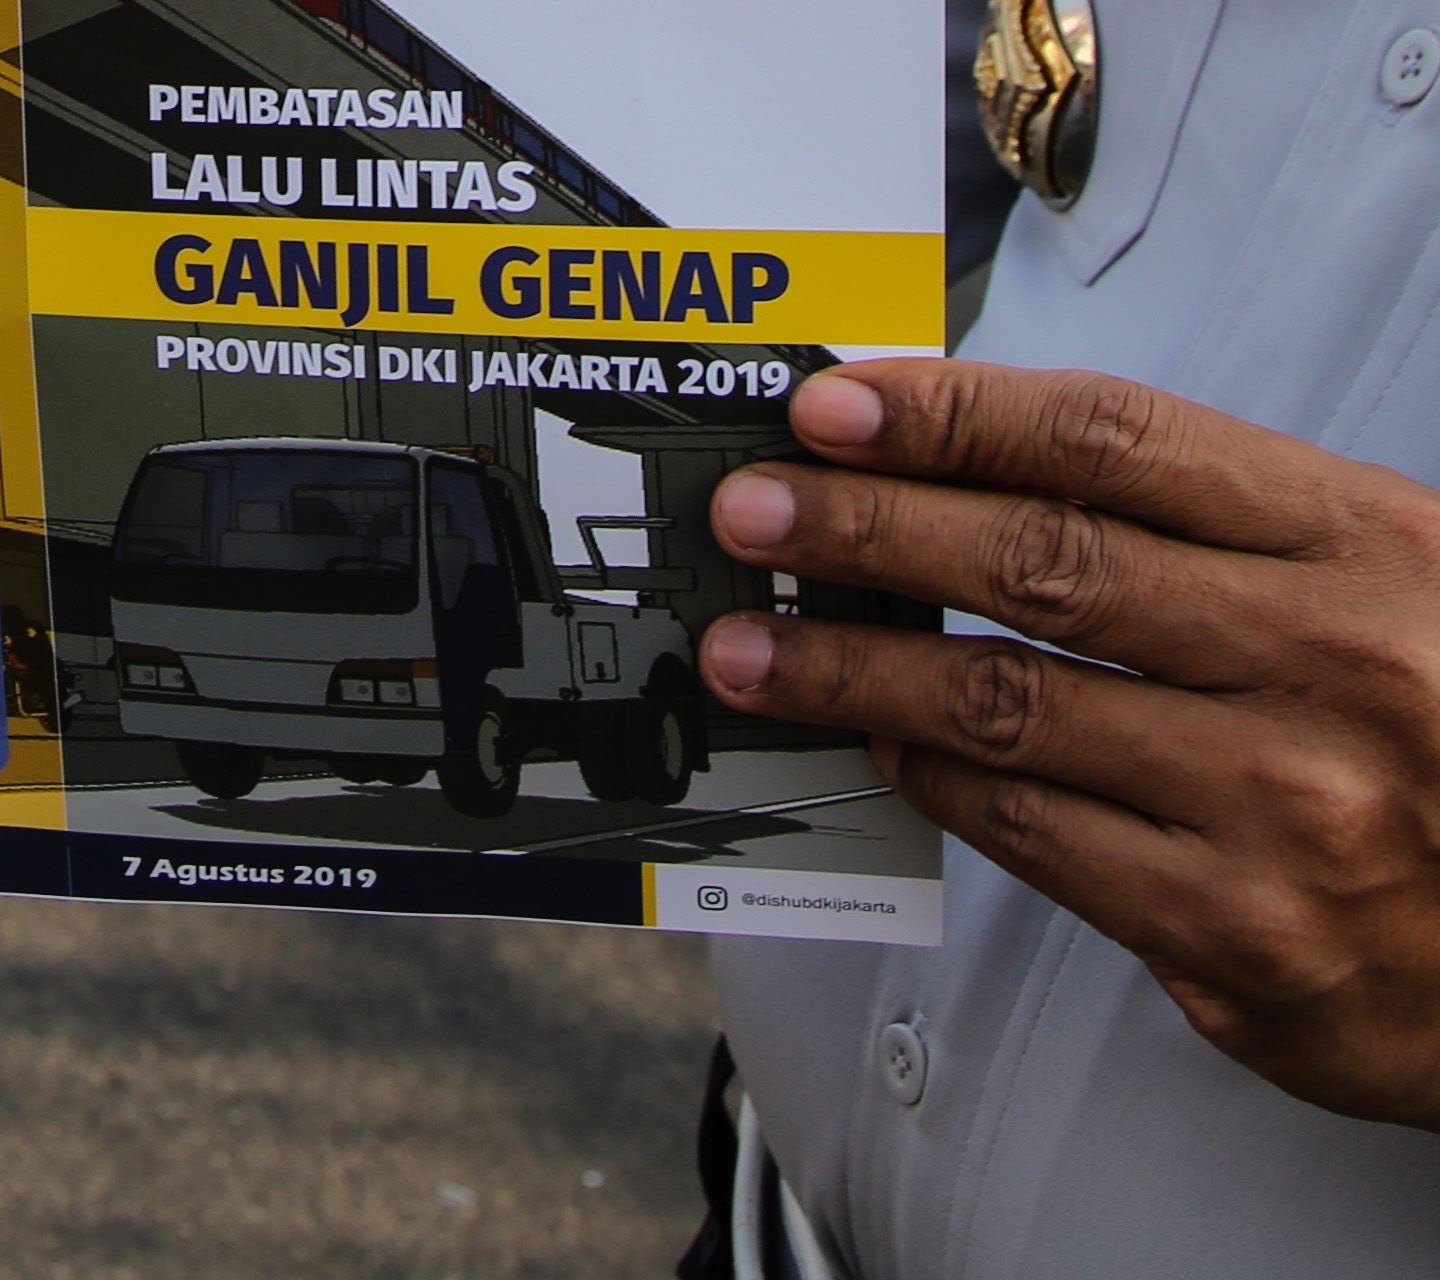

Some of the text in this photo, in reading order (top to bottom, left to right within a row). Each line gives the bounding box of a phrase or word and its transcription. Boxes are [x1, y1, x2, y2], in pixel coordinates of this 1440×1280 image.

[148, 83, 464, 130] PEMBATASAN
[150, 151, 539, 213] LALU LINTAS
[153, 233, 791, 329] GANJIL GENAP
[155, 334, 792, 399] PROVINSI DKI JAKARTA 2019
[122, 855, 378, 888] 7 Agustus 2019
[741, 891, 898, 915] @dishubdkijakarta
